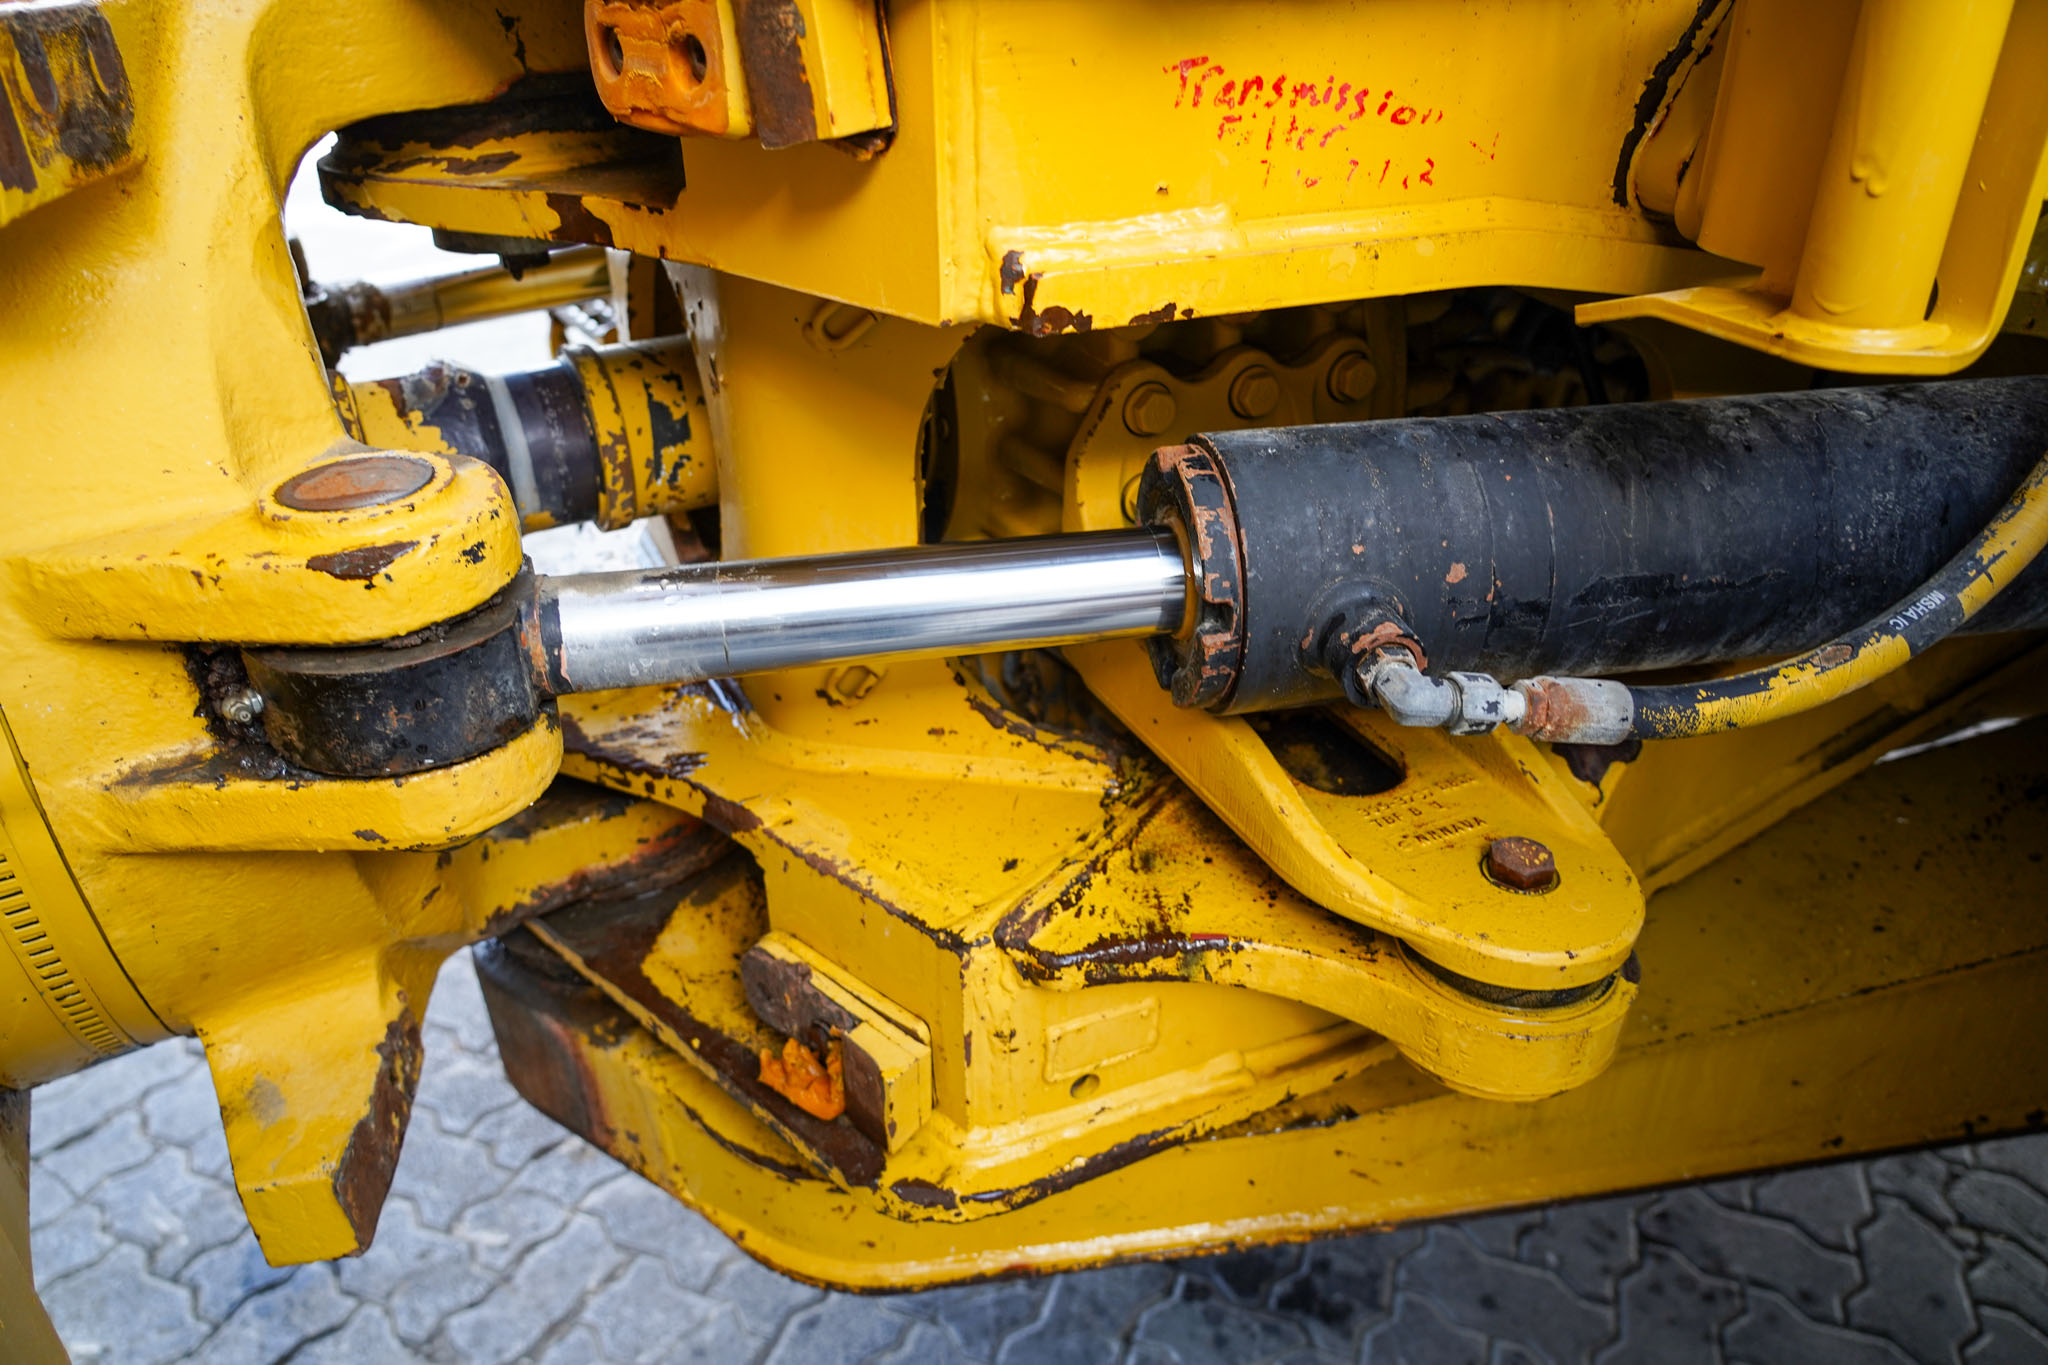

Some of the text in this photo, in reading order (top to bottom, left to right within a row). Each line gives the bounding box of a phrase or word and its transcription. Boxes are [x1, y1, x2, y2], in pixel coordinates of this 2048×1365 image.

[1165, 55, 1443, 125] Transmission
[1889, 589, 1946, 631] MSHA IC
